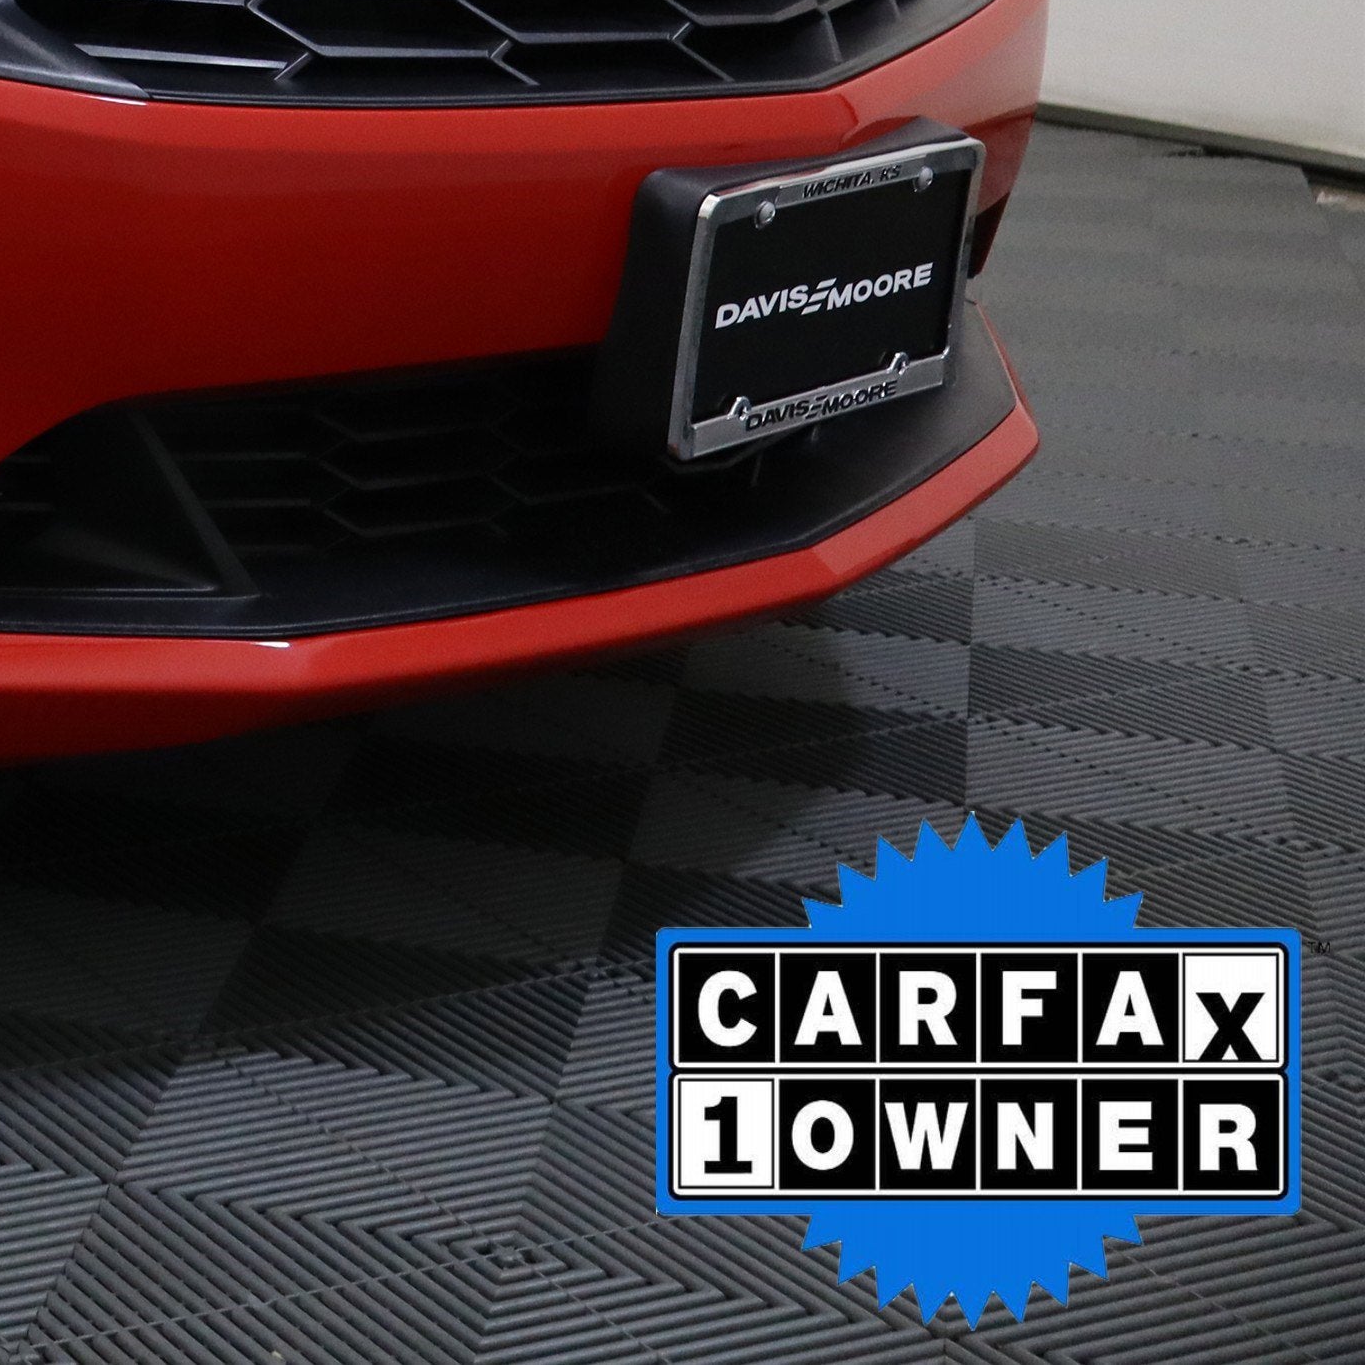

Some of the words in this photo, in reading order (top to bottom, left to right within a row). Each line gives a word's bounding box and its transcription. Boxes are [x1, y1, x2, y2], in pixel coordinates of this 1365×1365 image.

[879, 165, 902, 182] KS
[715, 287, 809, 329] DAVIS
[826, 262, 933, 311] MOORE
[745, 400, 810, 431] DAVIS
[822, 380, 898, 416] MOORE
